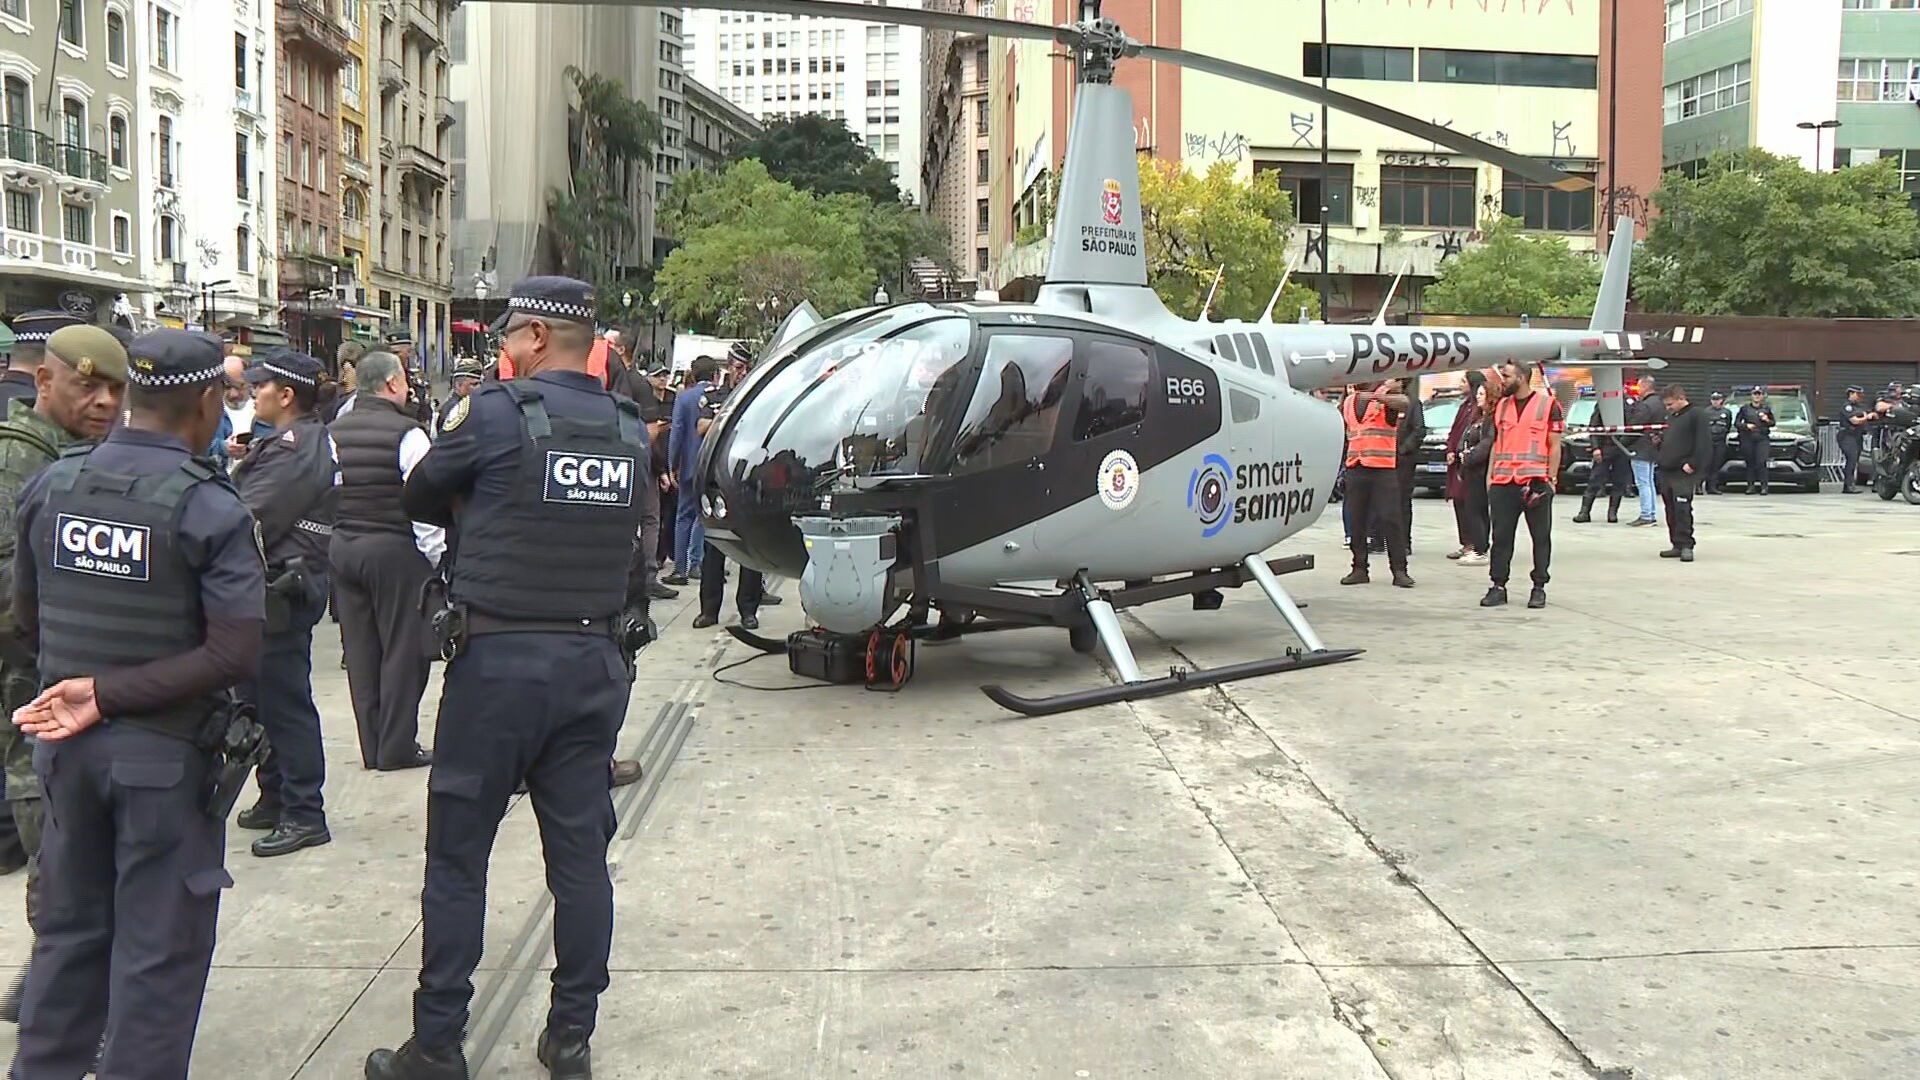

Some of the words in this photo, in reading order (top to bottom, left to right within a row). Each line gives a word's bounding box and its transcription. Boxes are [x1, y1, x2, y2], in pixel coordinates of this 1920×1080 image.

[1081, 225, 1128, 240] PREFEITURA
[1128, 231, 1137, 241] DE
[1082, 236, 1106, 252] SÃO
[1108, 240, 1137, 257] PAULO
[1346, 331, 1470, 374] PS-SPS
[1166, 377, 1205, 396] R66
[553, 456, 628, 489] GCM
[1236, 452, 1303, 490] smart
[566, 487, 588, 500] SÃO
[588, 490, 619, 502] PAULO
[1233, 487, 1314, 526] sampa
[62, 520, 143, 561] GCM
[74, 555, 95, 569] SÃO
[95, 559, 132, 574] PAULO
